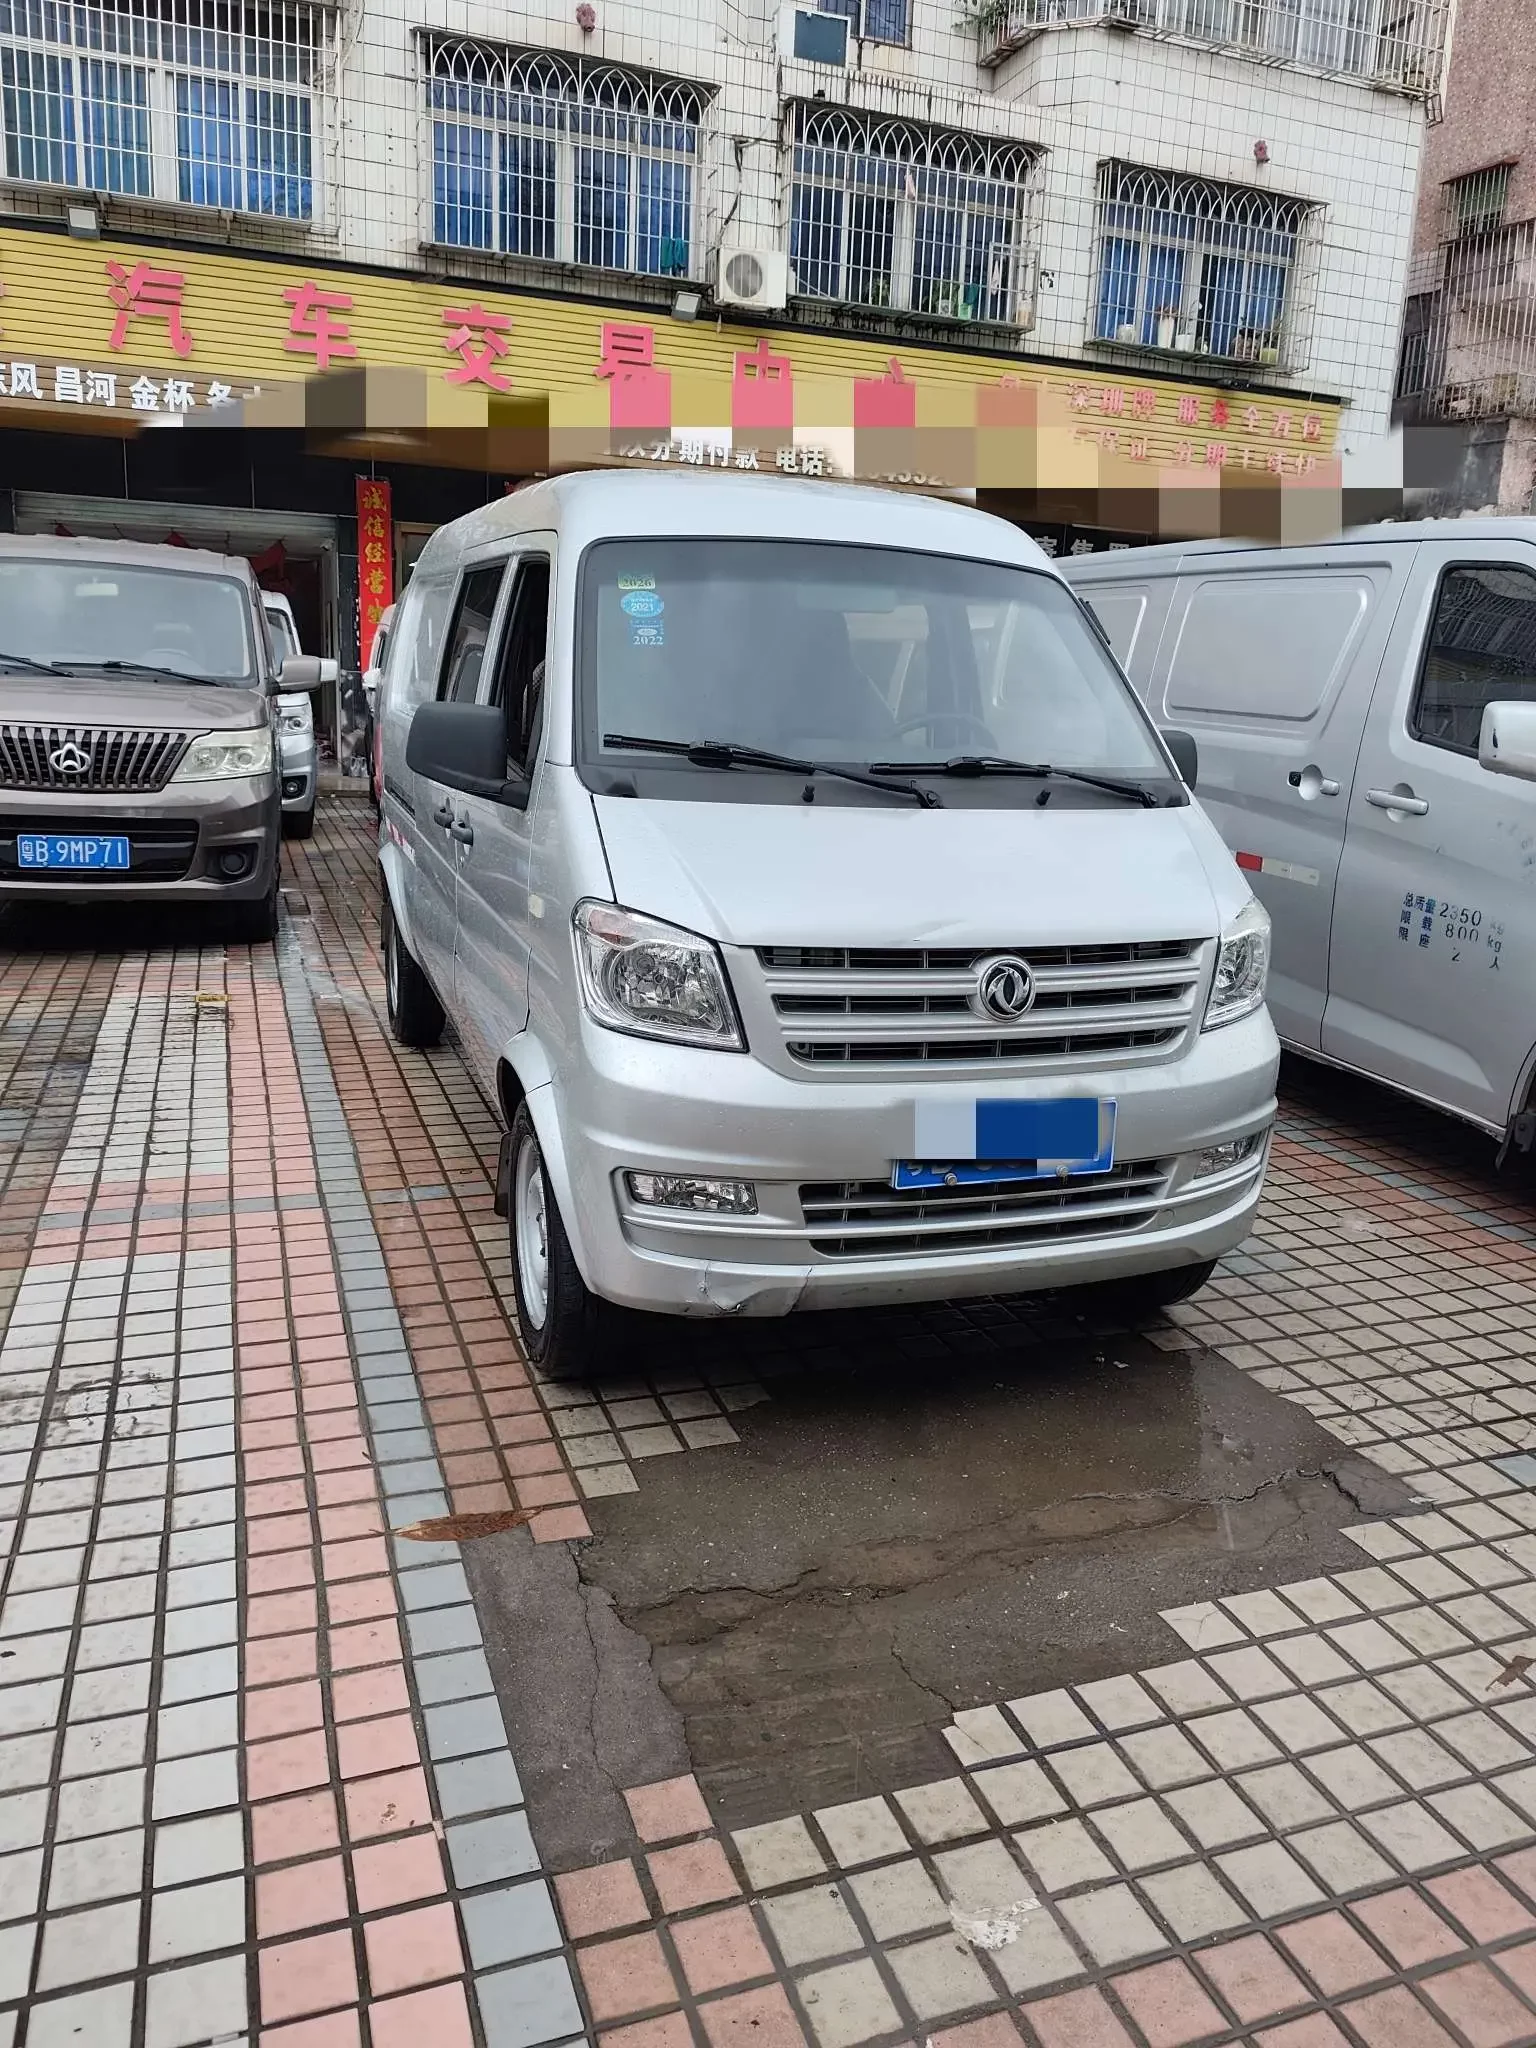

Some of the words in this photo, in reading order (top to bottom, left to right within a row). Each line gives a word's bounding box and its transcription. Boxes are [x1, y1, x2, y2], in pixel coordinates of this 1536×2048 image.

[105, 259, 906, 408] 汽车交易中
[54, 365, 117, 407] 昌河
[129, 375, 195, 413] 金杯
[633, 636, 664, 646] 2022
[1440, 902, 1482, 927] 2350
[1445, 923, 1479, 942] 800
[1487, 935, 1502, 953] kg
[1488, 955, 1500, 970] 人
